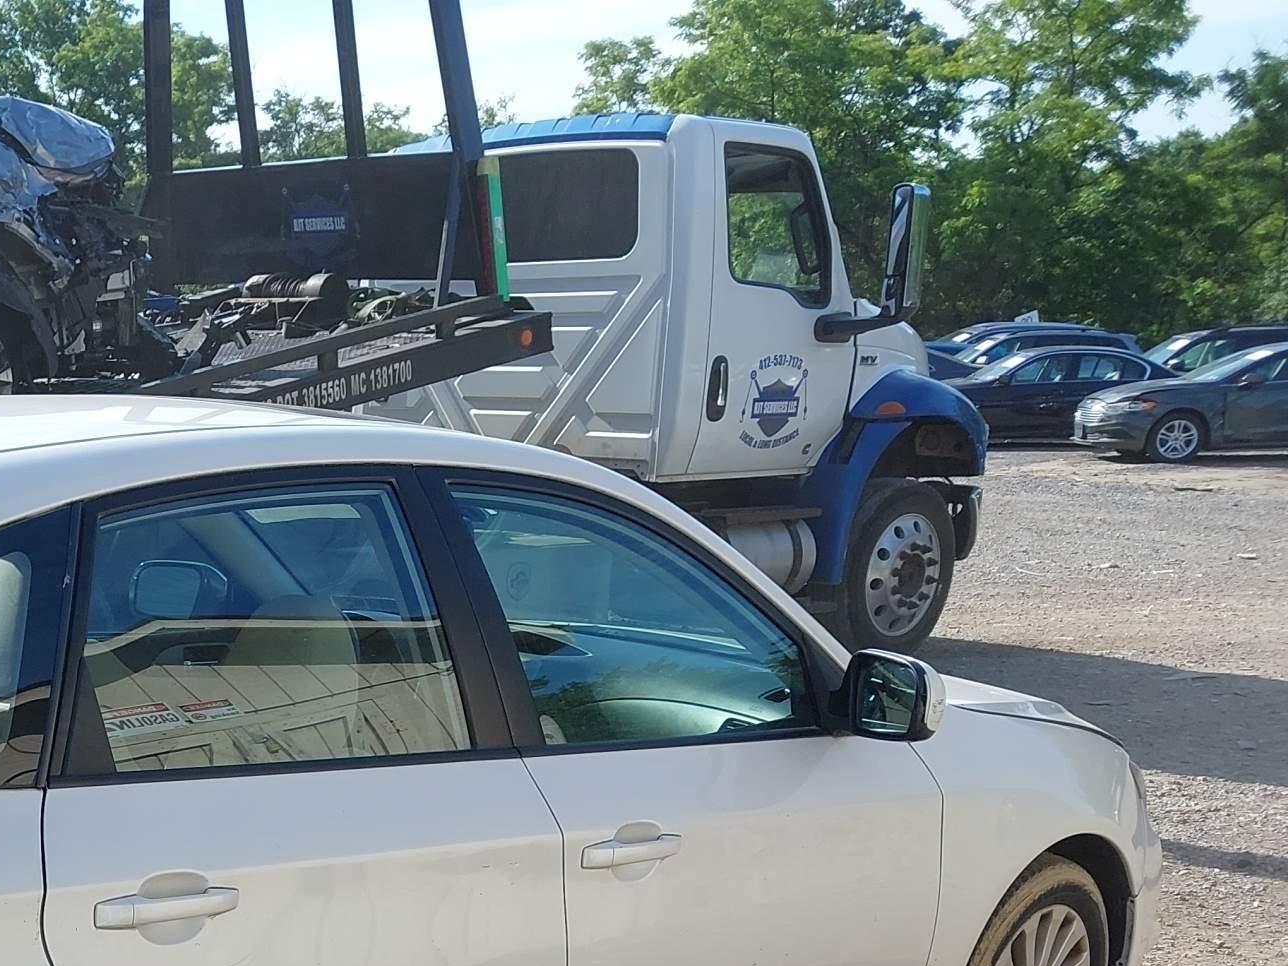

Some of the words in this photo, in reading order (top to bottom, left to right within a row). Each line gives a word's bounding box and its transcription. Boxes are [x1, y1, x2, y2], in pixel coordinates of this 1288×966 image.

[304, 216, 334, 232] SERVICES
[334, 215, 346, 231] LLC
[860, 355, 878, 366] MV
[302, 376, 347, 408] 3815560
[350, 371, 367, 396] MC
[369, 359, 413, 392] 1381700
[763, 400, 789, 414] SERVICES
[788, 400, 798, 413] LLC
[771, 427, 800, 449] DISTANCE
